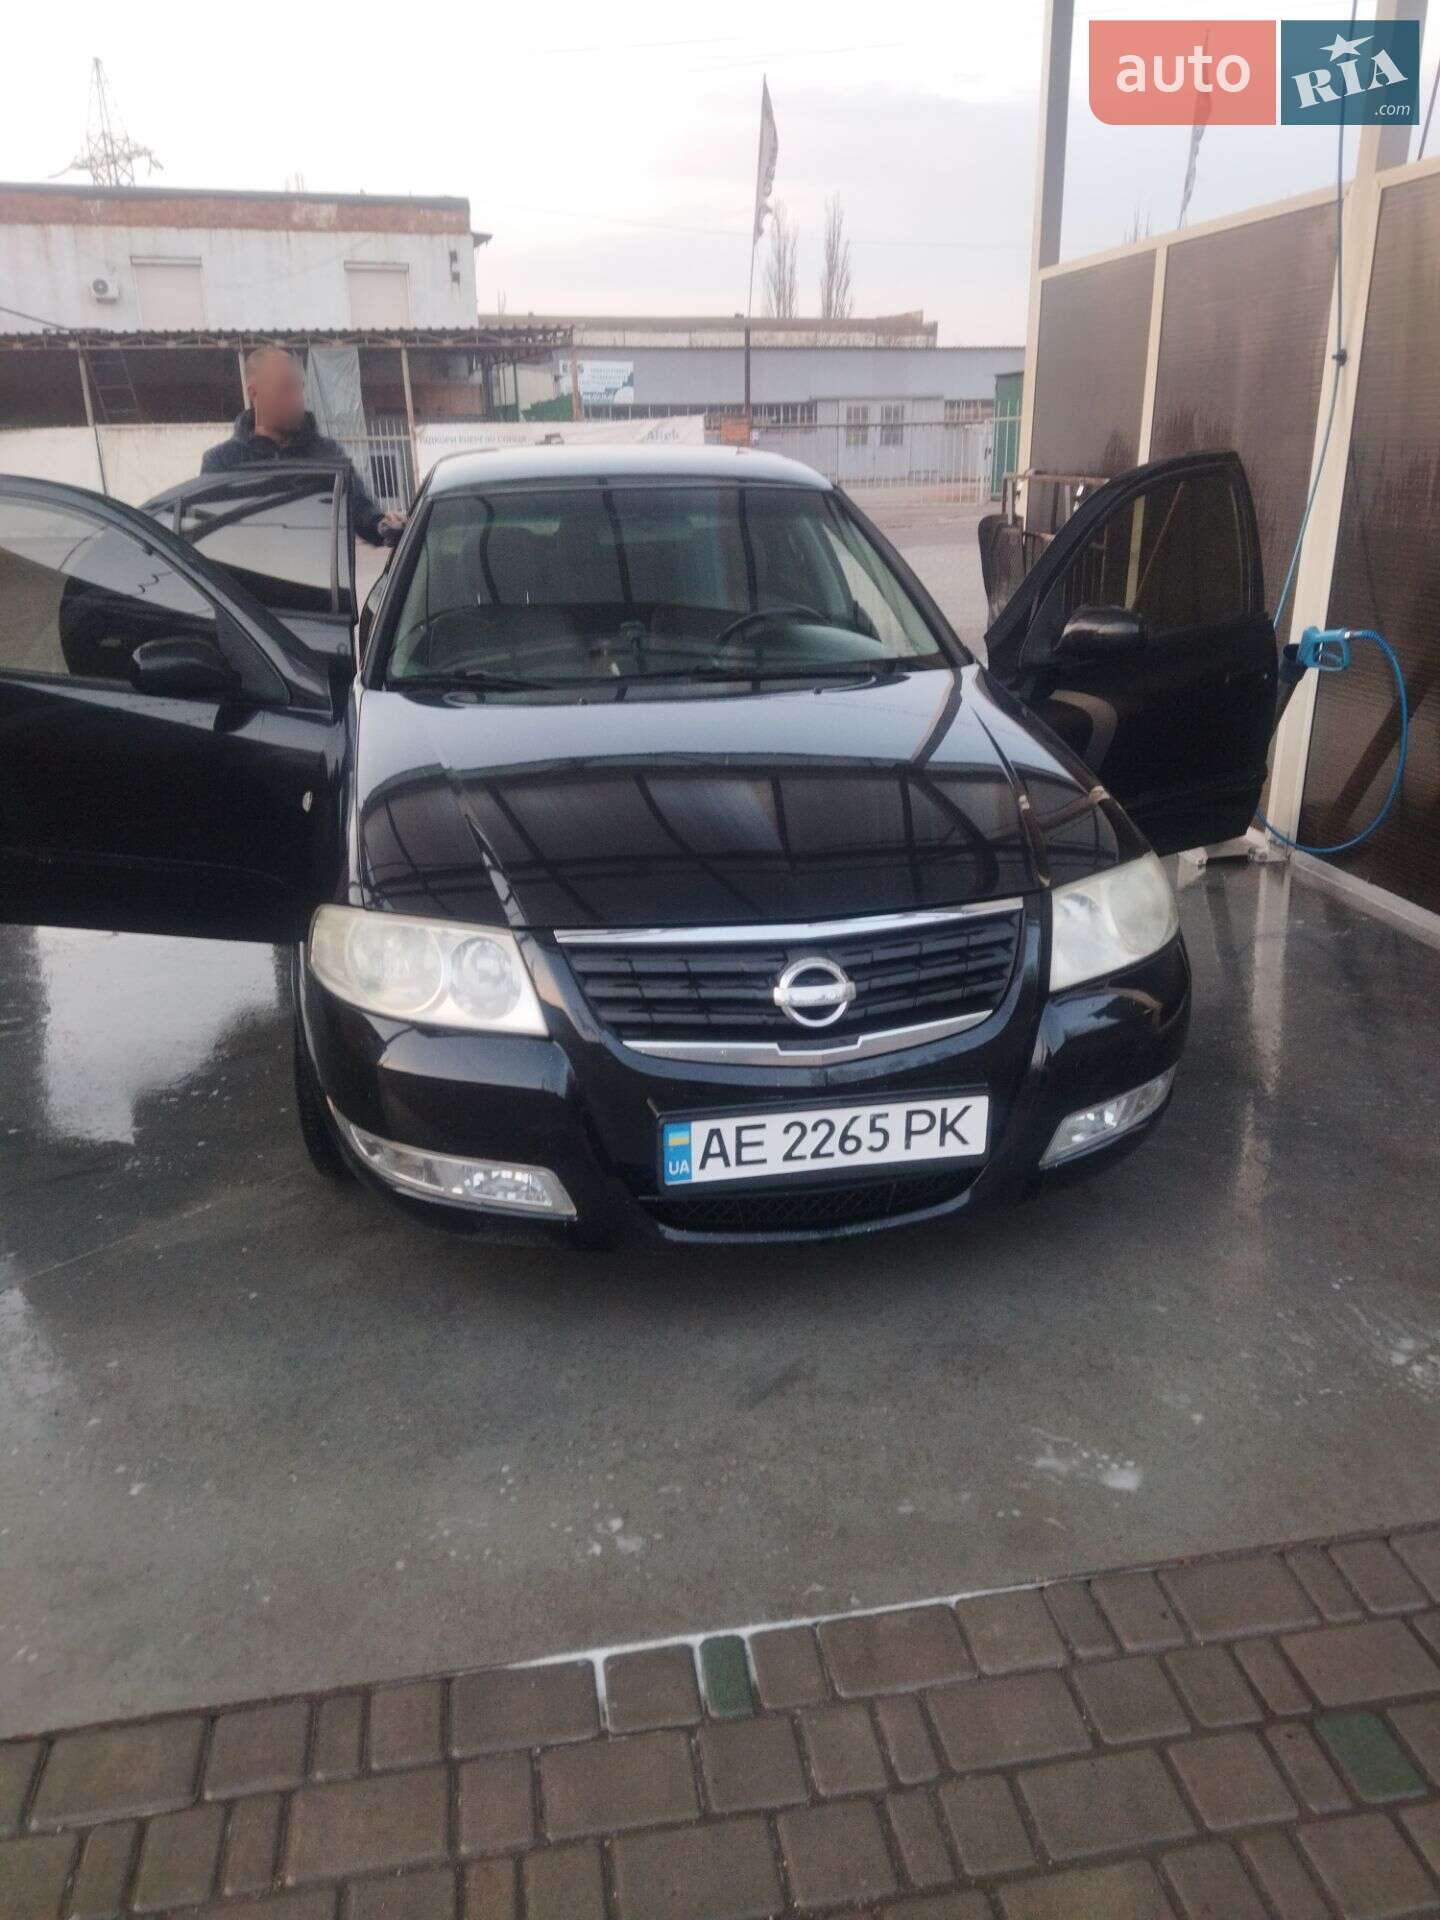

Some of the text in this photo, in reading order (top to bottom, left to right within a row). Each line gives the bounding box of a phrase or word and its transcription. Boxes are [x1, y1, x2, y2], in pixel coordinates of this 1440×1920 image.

[699, 1105, 972, 1170] AE 2265 PK
[668, 1162, 690, 1176] UA
